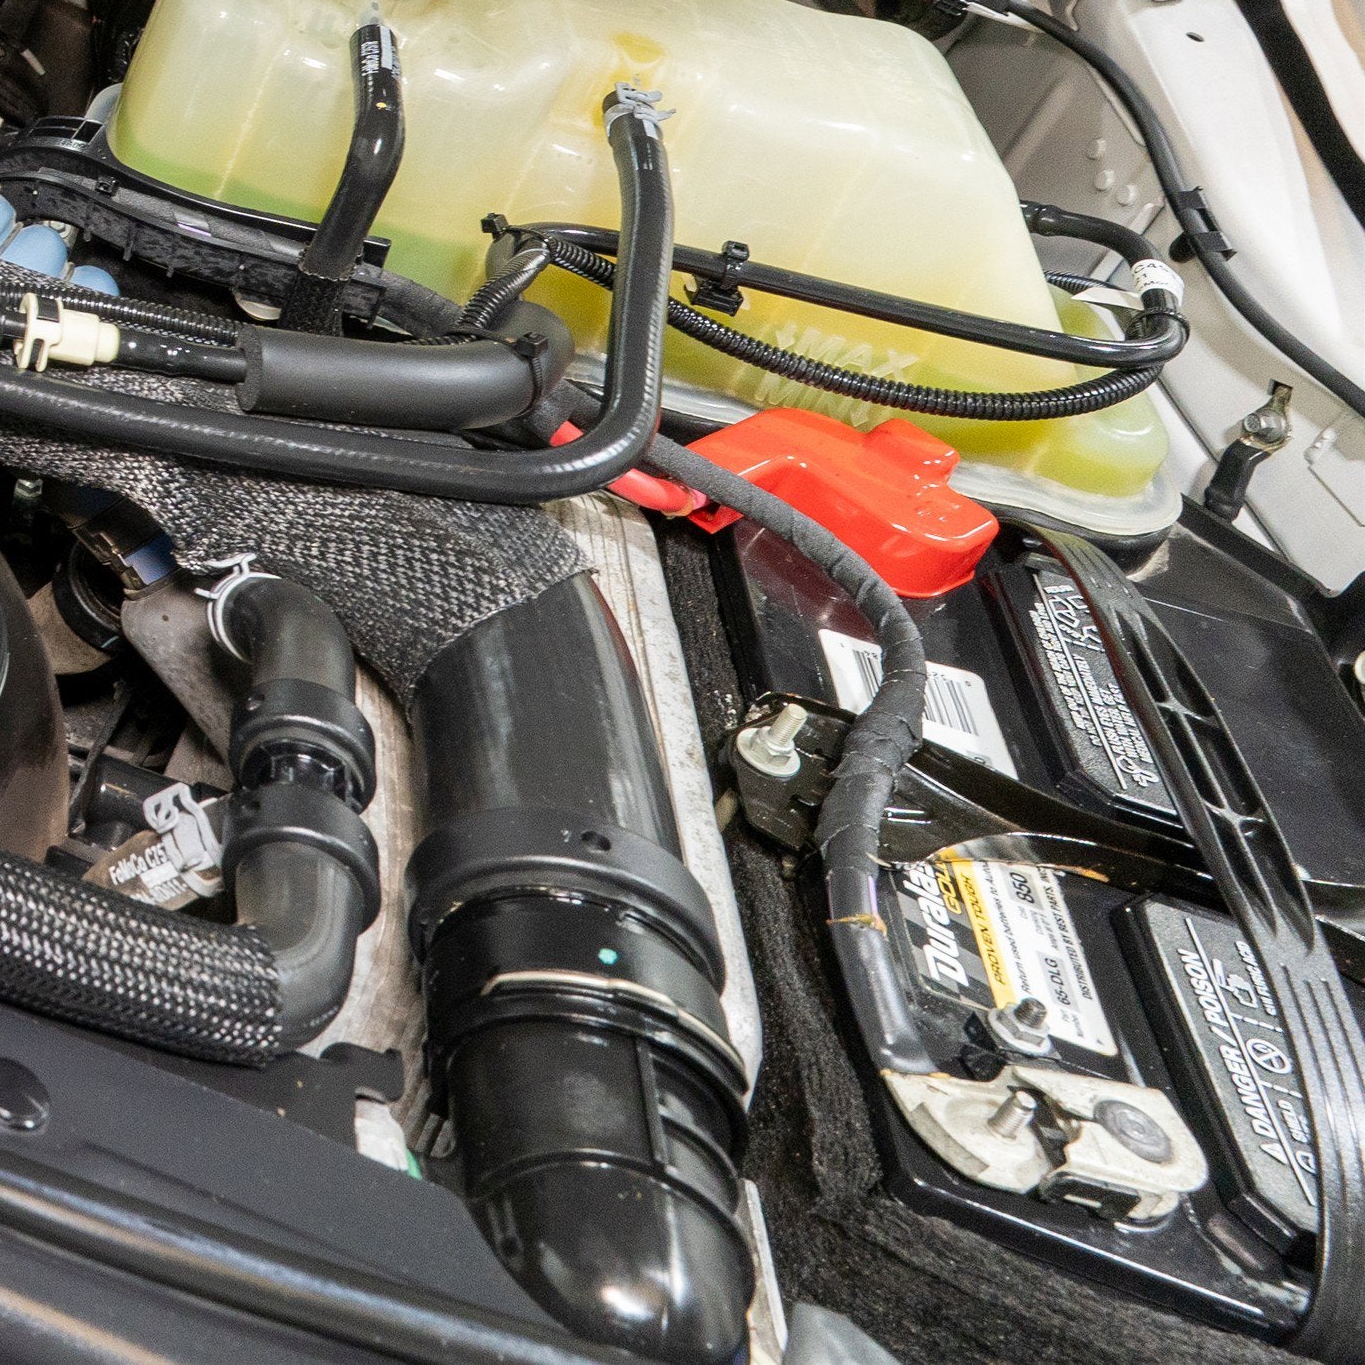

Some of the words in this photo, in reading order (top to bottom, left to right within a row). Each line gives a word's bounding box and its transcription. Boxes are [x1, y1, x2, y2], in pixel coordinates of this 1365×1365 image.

[792, 322, 920, 386] MAX
[960, 872, 985, 921] TOUGH
[989, 886, 999, 896] to
[1008, 871, 1034, 904] 850
[993, 897, 1013, 936] batteries
[1053, 911, 1069, 933] BEST
[977, 923, 1005, 985] PROVEN
[1003, 936, 1021, 960] used
[1061, 933, 1073, 945] BY
[1015, 962, 1033, 994] Return
[1043, 956, 1071, 1006] 65-DLG
[1065, 945, 1093, 1000] DISTRIBUTED
[1178, 949, 1223, 1027] POISON
[1221, 1043, 1275, 1139] DANGER
